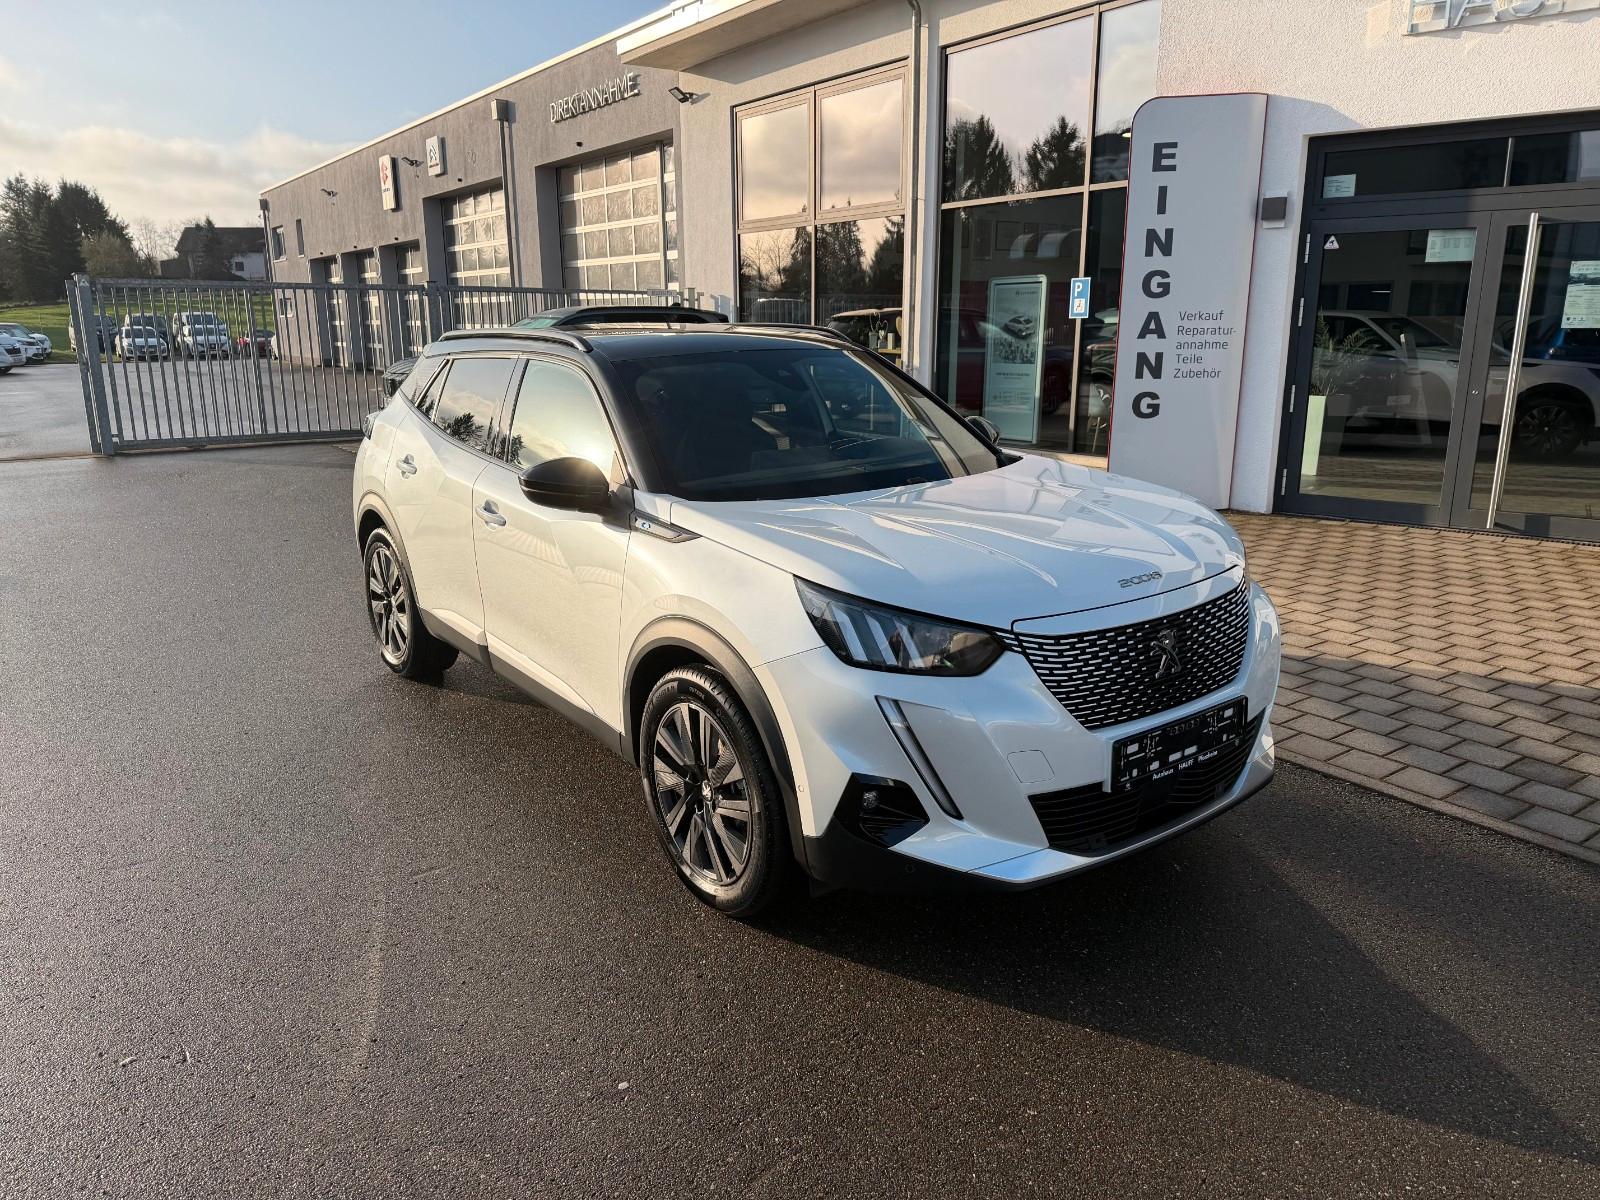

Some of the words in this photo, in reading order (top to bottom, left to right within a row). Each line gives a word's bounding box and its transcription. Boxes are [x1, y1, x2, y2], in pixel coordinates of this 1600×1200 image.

[549, 72, 639, 122] DIREKTANNAHME
[1131, 141, 1178, 419] EINGANG
[1074, 282, 1083, 297] P
[1178, 310, 1225, 321] Verkauf
[1177, 325, 1237, 338] Reparatur-
[1175, 339, 1229, 350] annahme
[1175, 353, 1203, 364] Teile
[1173, 367, 1222, 379] Zubehör
